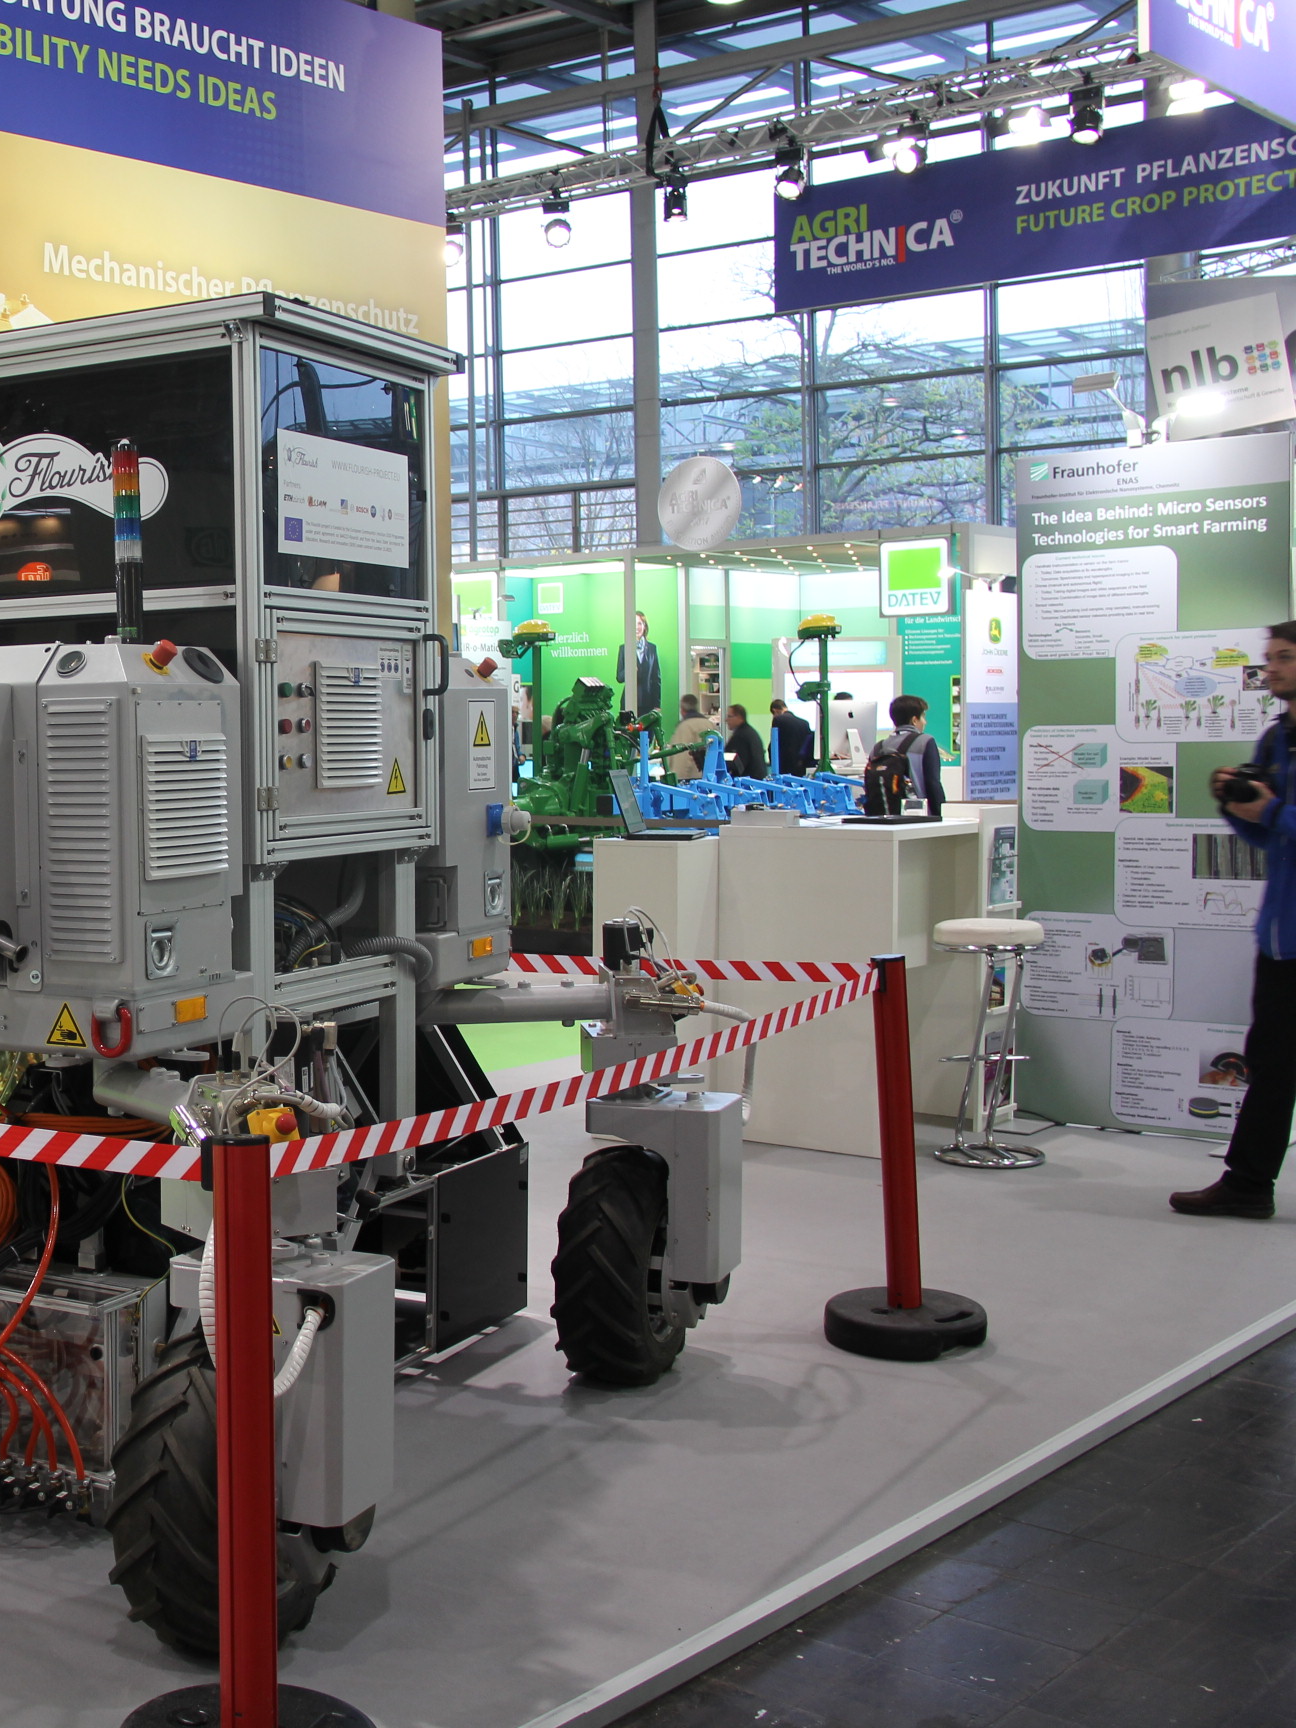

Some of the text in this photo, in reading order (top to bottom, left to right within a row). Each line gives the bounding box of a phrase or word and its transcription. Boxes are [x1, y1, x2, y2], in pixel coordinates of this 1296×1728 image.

[134, 6, 265, 69] BRAUCHT
[271, 45, 346, 92] IDEEN
[98, 48, 191, 99] NEEDS
[198, 73, 277, 120] IDEAS
[1015, 167, 1125, 205] ZUKUNFT
[1016, 169, 1296, 234] FUTURE CROP PROTECT
[790, 204, 868, 244] AGRI
[43, 242, 234, 299] Mechanischer
[827, 266, 842, 275] THE
[843, 259, 880, 273] WORLD'S
[1161, 346, 1239, 394] nlb
[1053, 460, 1138, 479] Fraunhofer
[1117, 477, 1139, 485] ENAS
[1032, 494, 1267, 525] The Idea Behind: Micro Sensors
[1032, 516, 1268, 546] Technologies for Smart Farming
[888, 591, 941, 607] DATEV
[551, 647, 608, 658] willkommen
